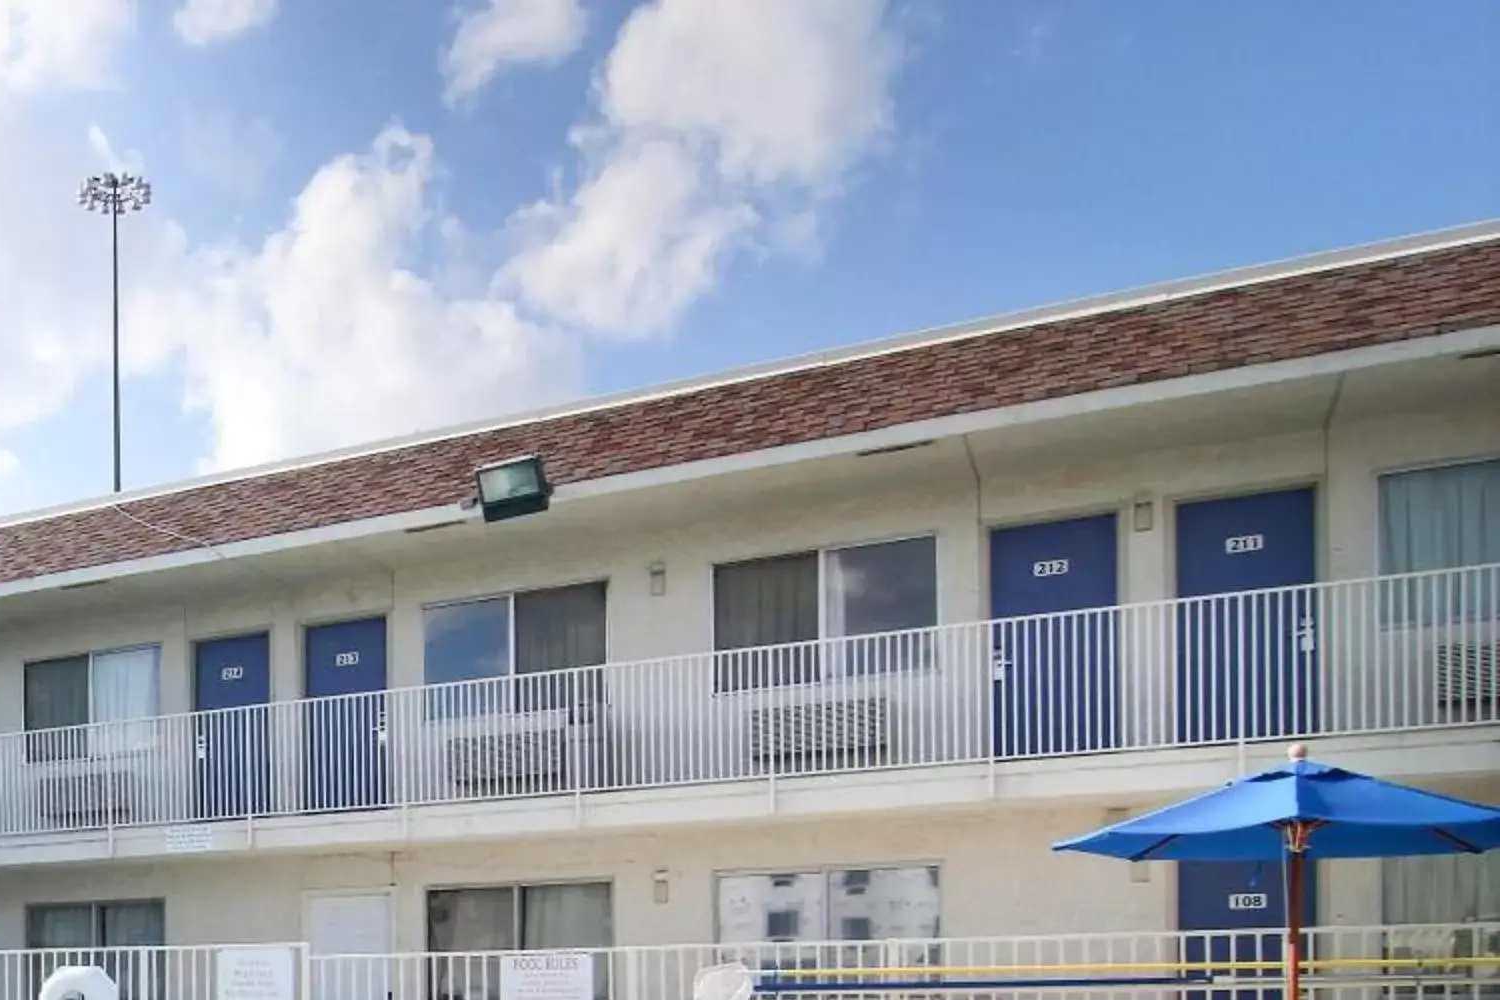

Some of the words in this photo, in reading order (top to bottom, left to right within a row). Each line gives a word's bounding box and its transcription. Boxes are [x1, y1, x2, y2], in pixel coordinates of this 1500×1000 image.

[1230, 537, 1260, 551] 211
[1036, 560, 1067, 574] 212
[1234, 895, 1263, 907] 108
